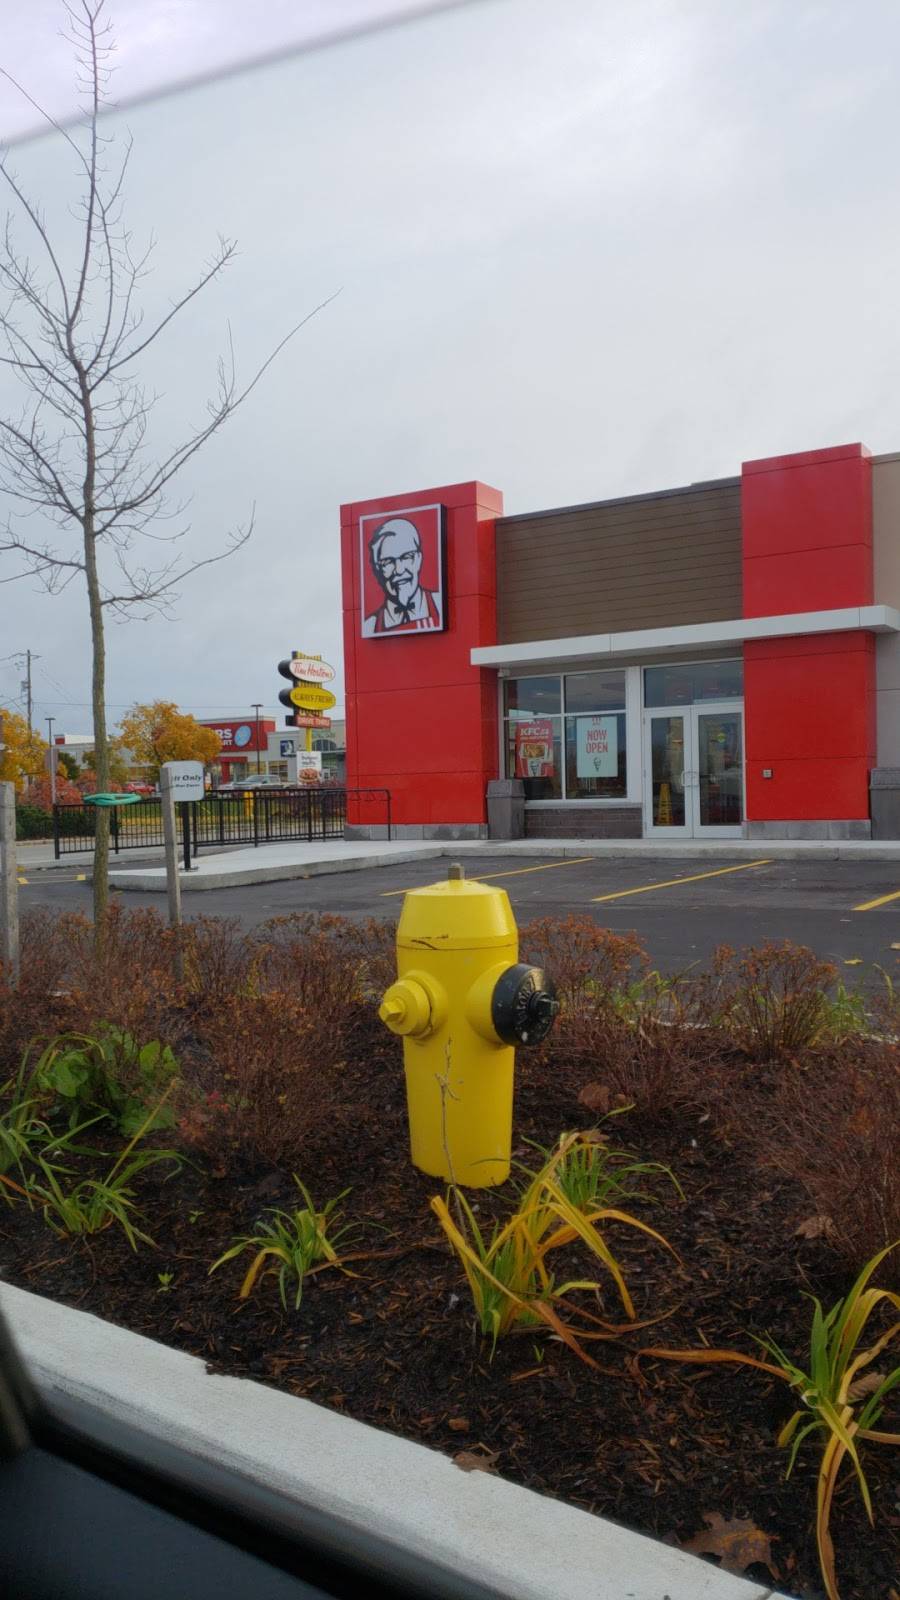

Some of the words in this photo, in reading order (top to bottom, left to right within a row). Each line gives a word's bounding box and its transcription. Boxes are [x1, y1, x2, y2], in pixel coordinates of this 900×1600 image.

[294, 662, 306, 676] Tim
[587, 729, 607, 741] NOW
[586, 742, 608, 753] OPEN
[182, 774, 202, 783] Only
